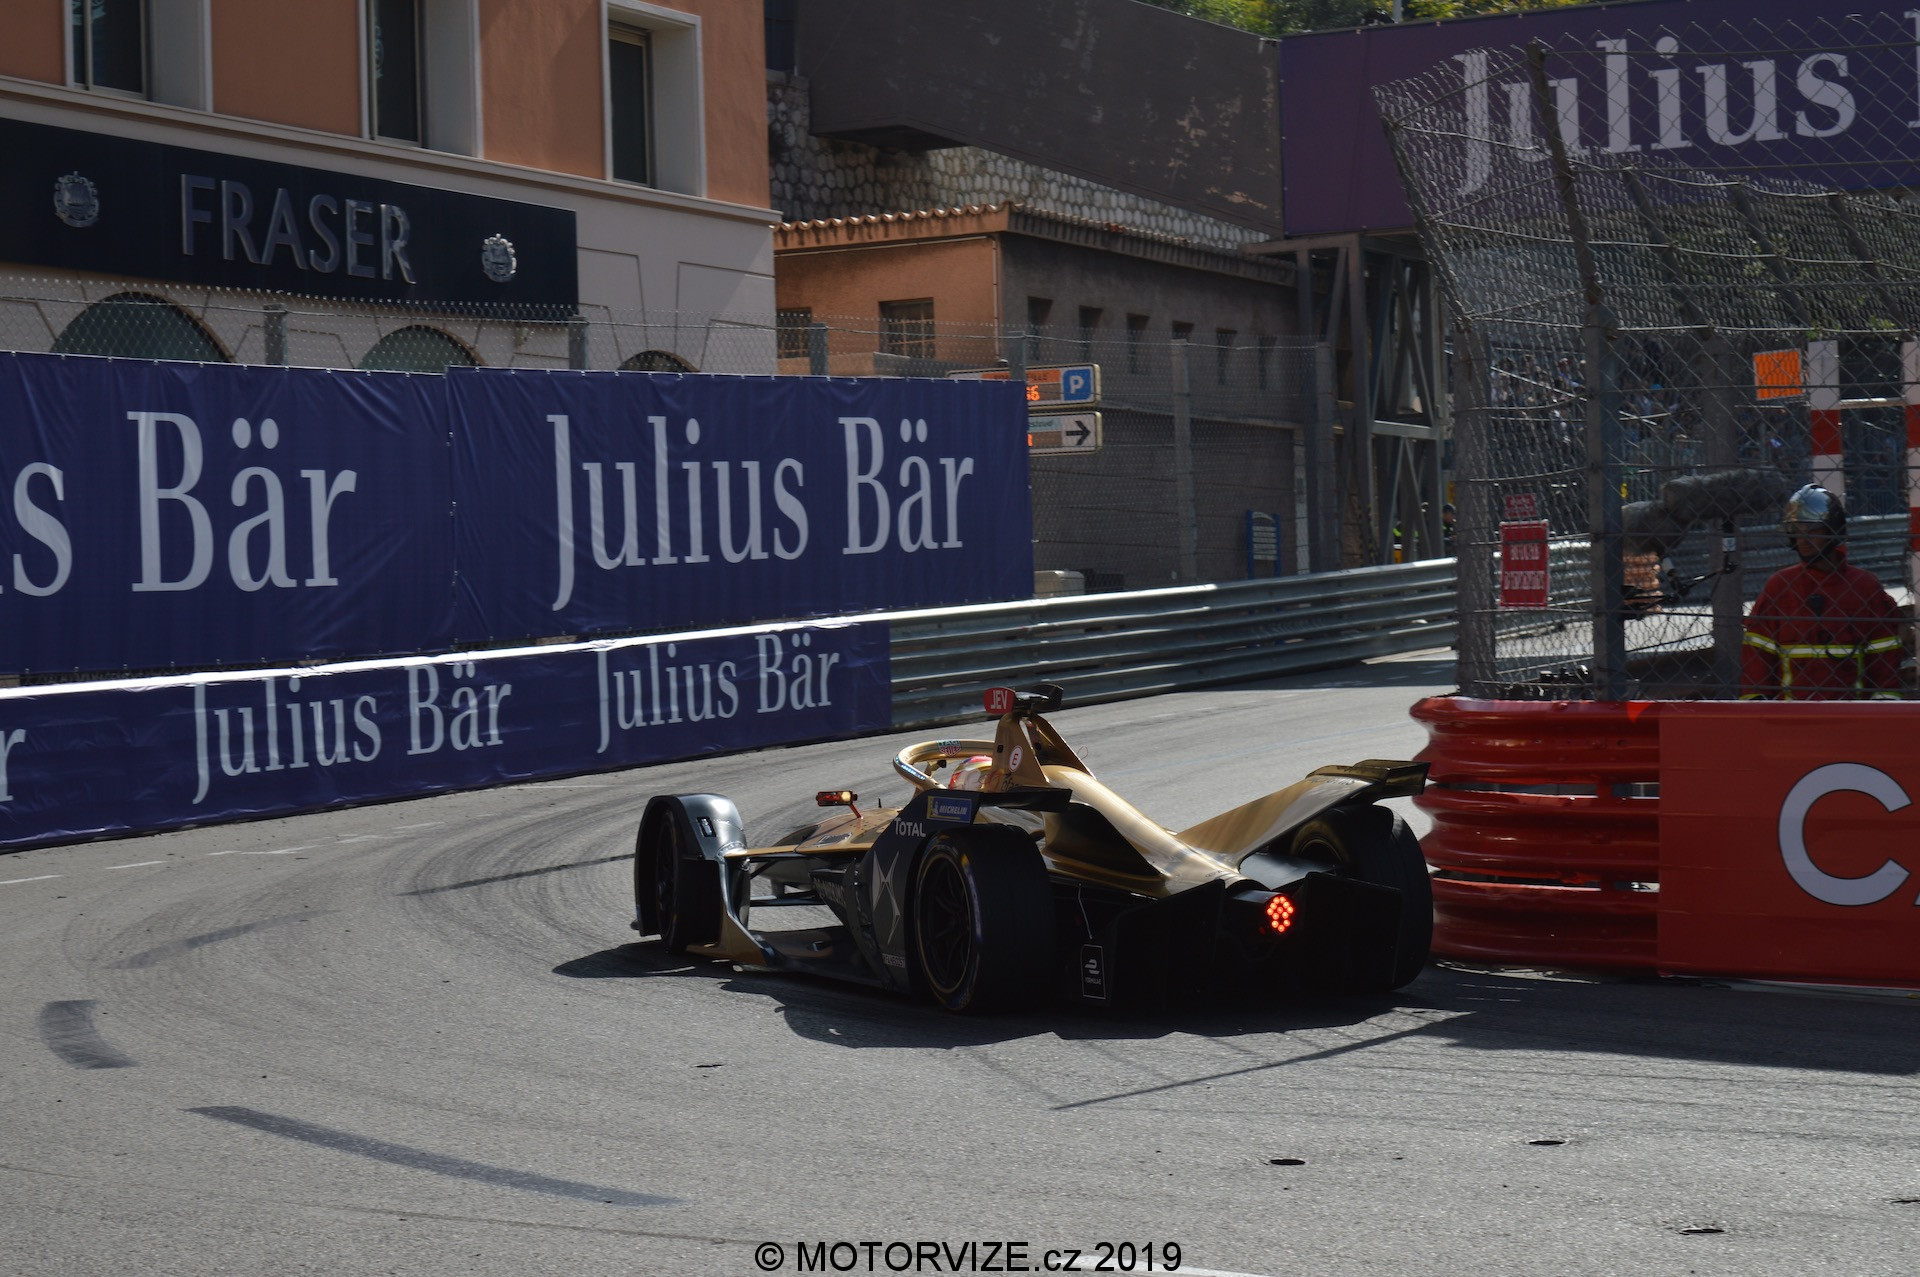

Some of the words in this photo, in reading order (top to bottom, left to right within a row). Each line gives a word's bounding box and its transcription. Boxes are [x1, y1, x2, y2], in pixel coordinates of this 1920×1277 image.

[1453, 36, 1857, 197] Julius
[180, 173, 416, 286] FRASER
[1069, 375, 1084, 395] P
[127, 411, 357, 592] Bär
[547, 415, 809, 612] Julius
[838, 416, 974, 555] Bär
[193, 677, 382, 805] Julius
[406, 661, 512, 756] Bär
[596, 640, 738, 754] Julius
[755, 632, 840, 714] Bär
[990, 689, 1008, 710] JEV
[939, 805, 968, 815] MICHELIN
[1777, 761, 1920, 908] C
